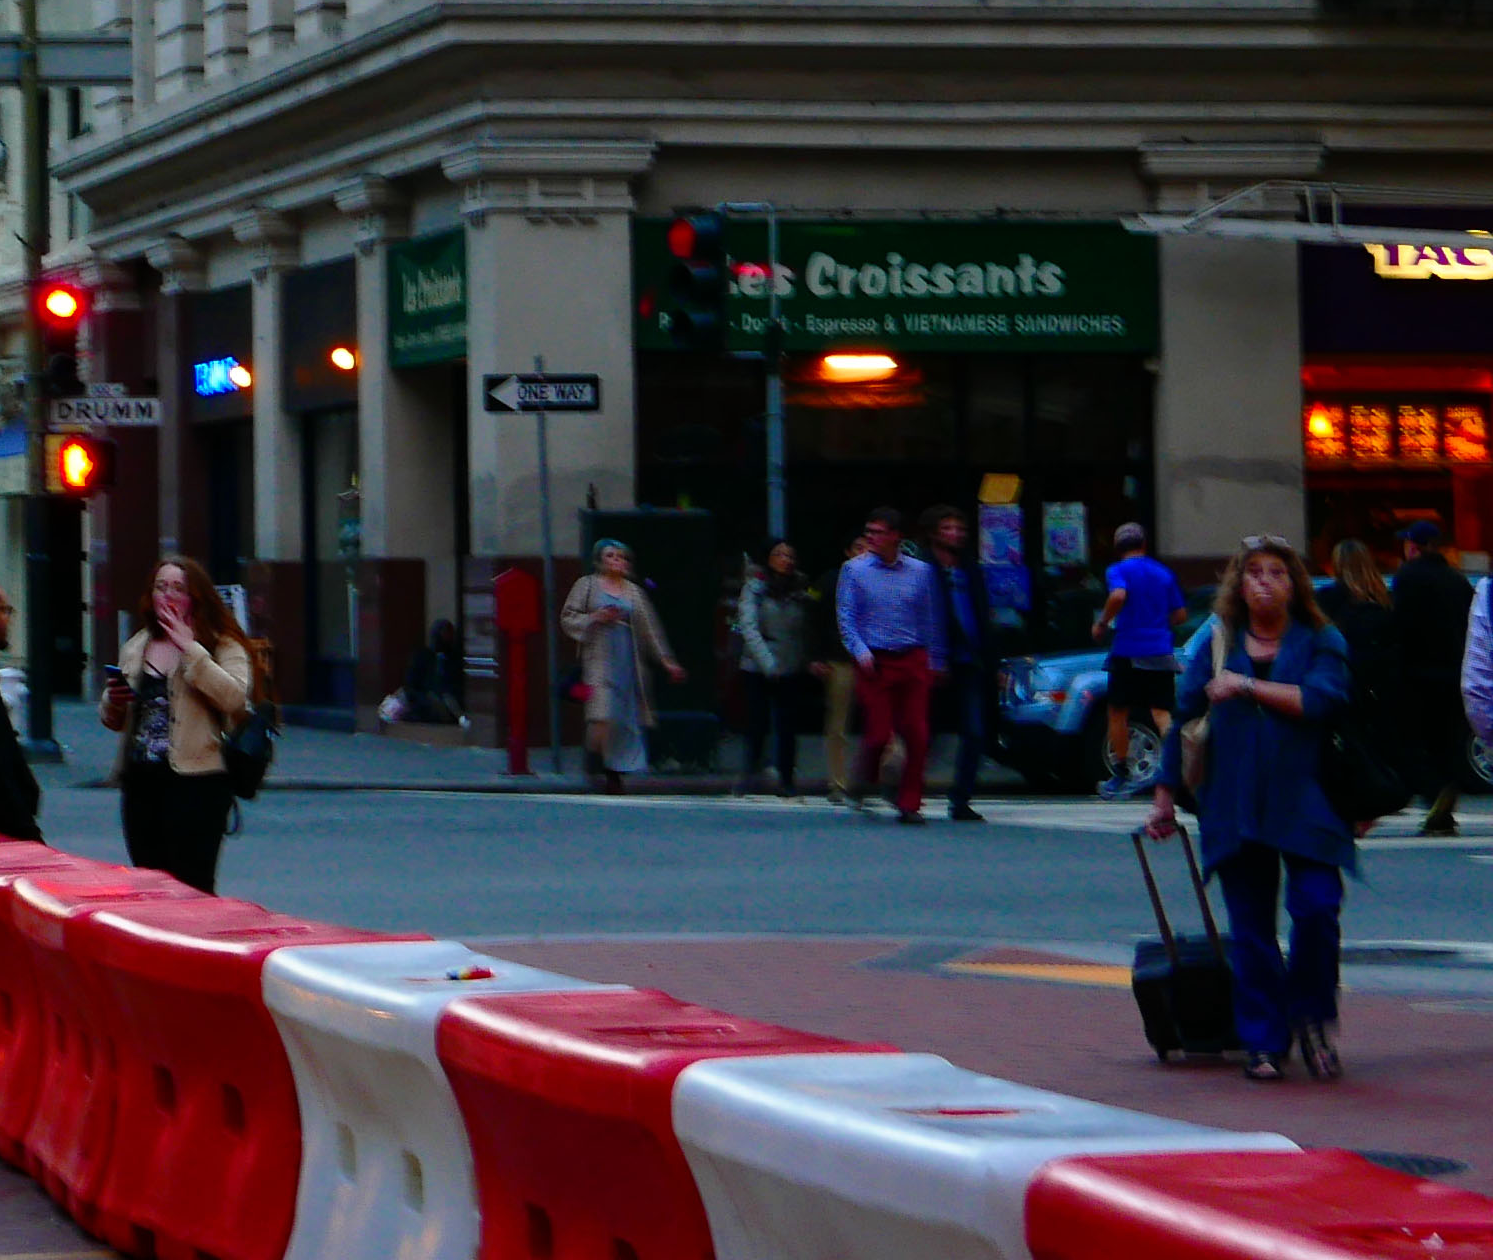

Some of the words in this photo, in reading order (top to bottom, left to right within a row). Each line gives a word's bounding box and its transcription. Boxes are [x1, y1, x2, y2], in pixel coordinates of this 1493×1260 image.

[805, 250, 1068, 299] Croissants
[741, 313, 788, 334] Dot
[806, 313, 879, 336] Espresso
[884, 314, 896, 332] &
[903, 313, 1009, 334] VIETNAMESE
[1014, 314, 1126, 335] SANDWICHES
[517, 384, 550, 401] ONE
[555, 384, 587, 400] WAY
[57, 401, 153, 420] DRUMM
